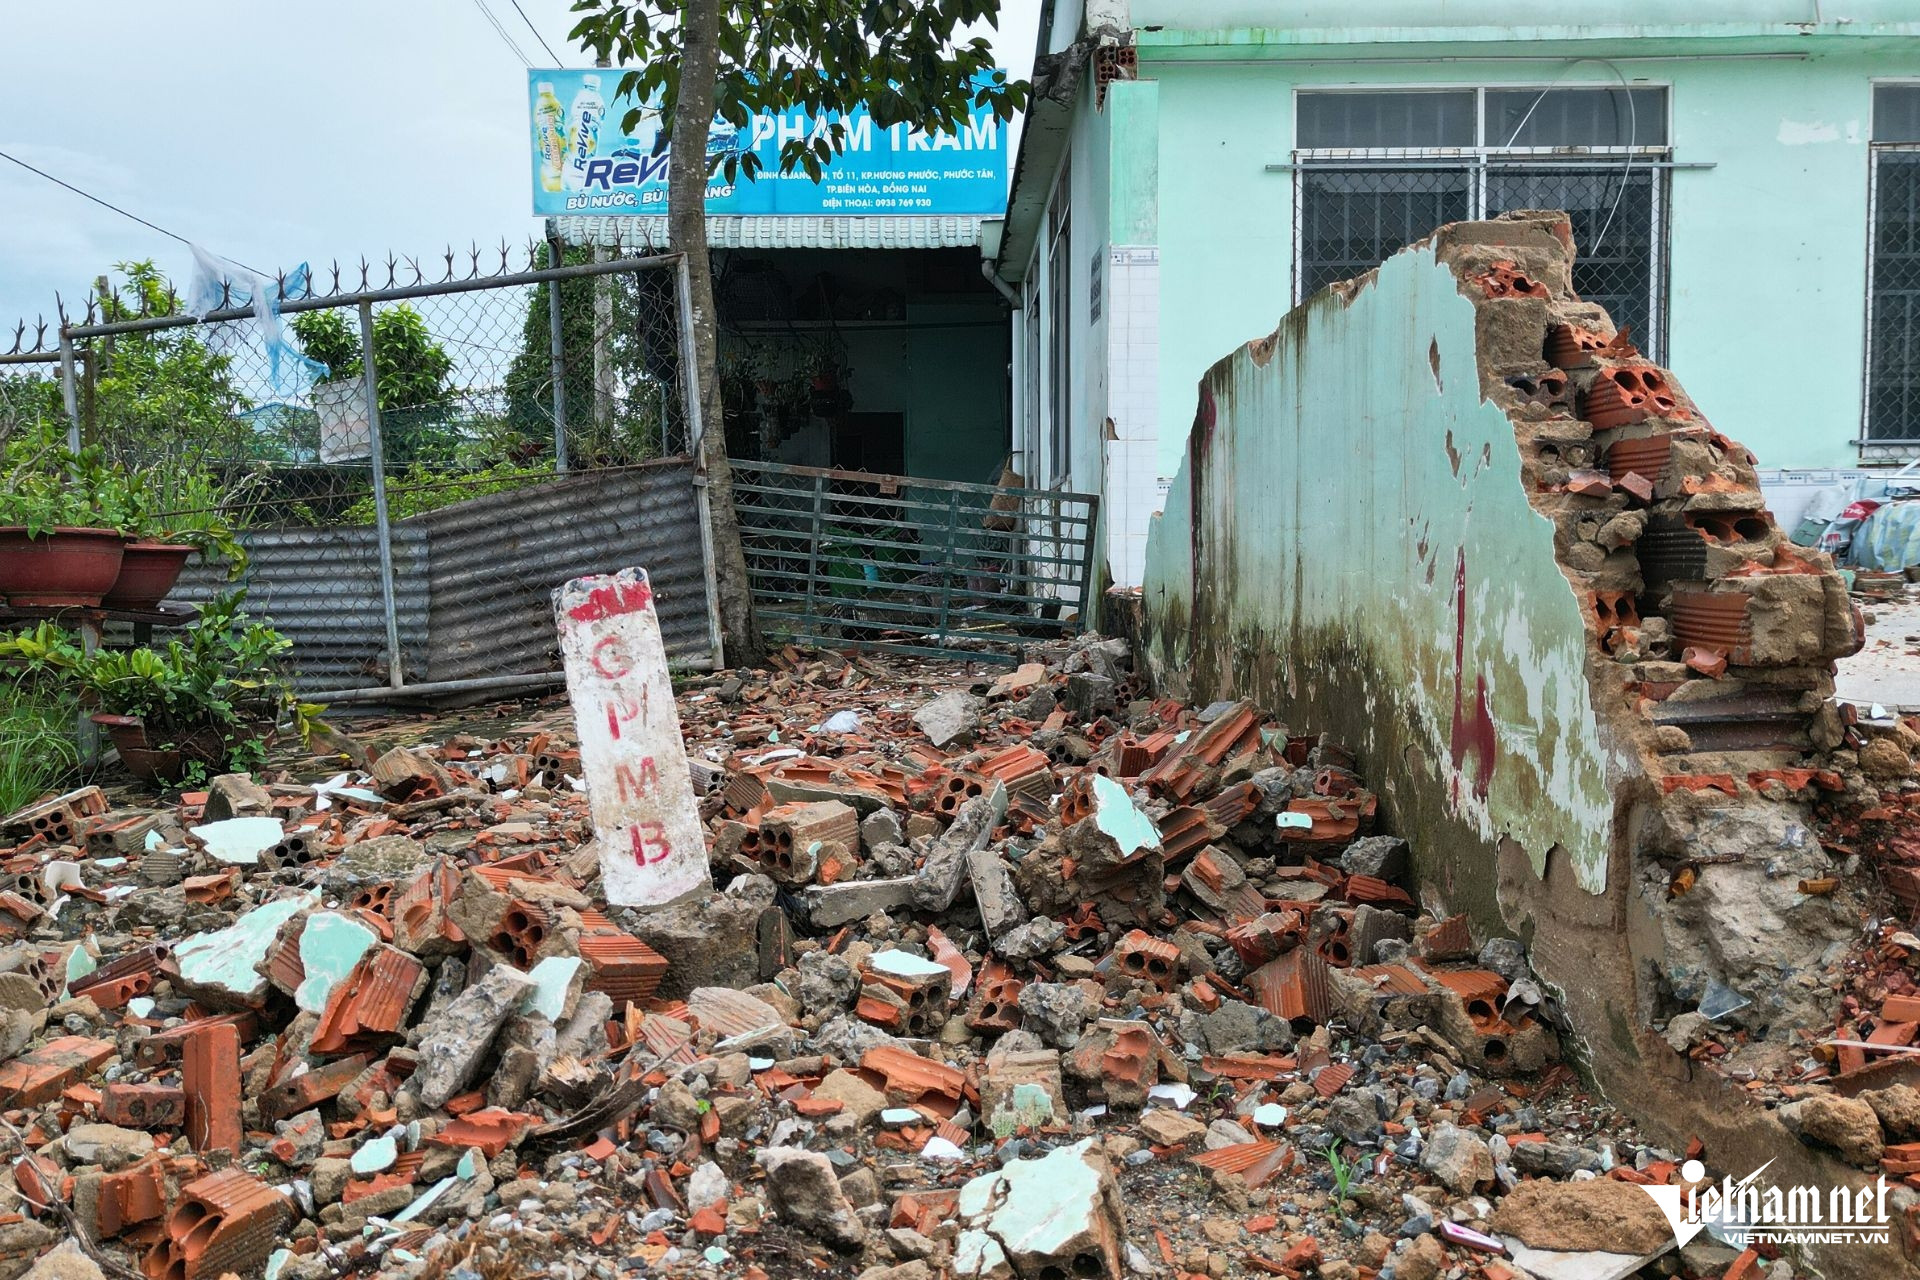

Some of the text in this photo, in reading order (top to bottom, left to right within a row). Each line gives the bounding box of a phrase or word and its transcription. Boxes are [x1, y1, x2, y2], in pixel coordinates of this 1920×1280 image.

[847, 171, 859, 181] 11,
[944, 168, 975, 180] PHƯỚC
[911, 184, 927, 193] NAI
[566, 191, 590, 210] BÙ
[591, 190, 638, 209] NƯỚC,
[642, 187, 665, 204] BÙ
[875, 198, 896, 207] 0938
[898, 198, 914, 207] 769
[916, 198, 932, 207] 930
